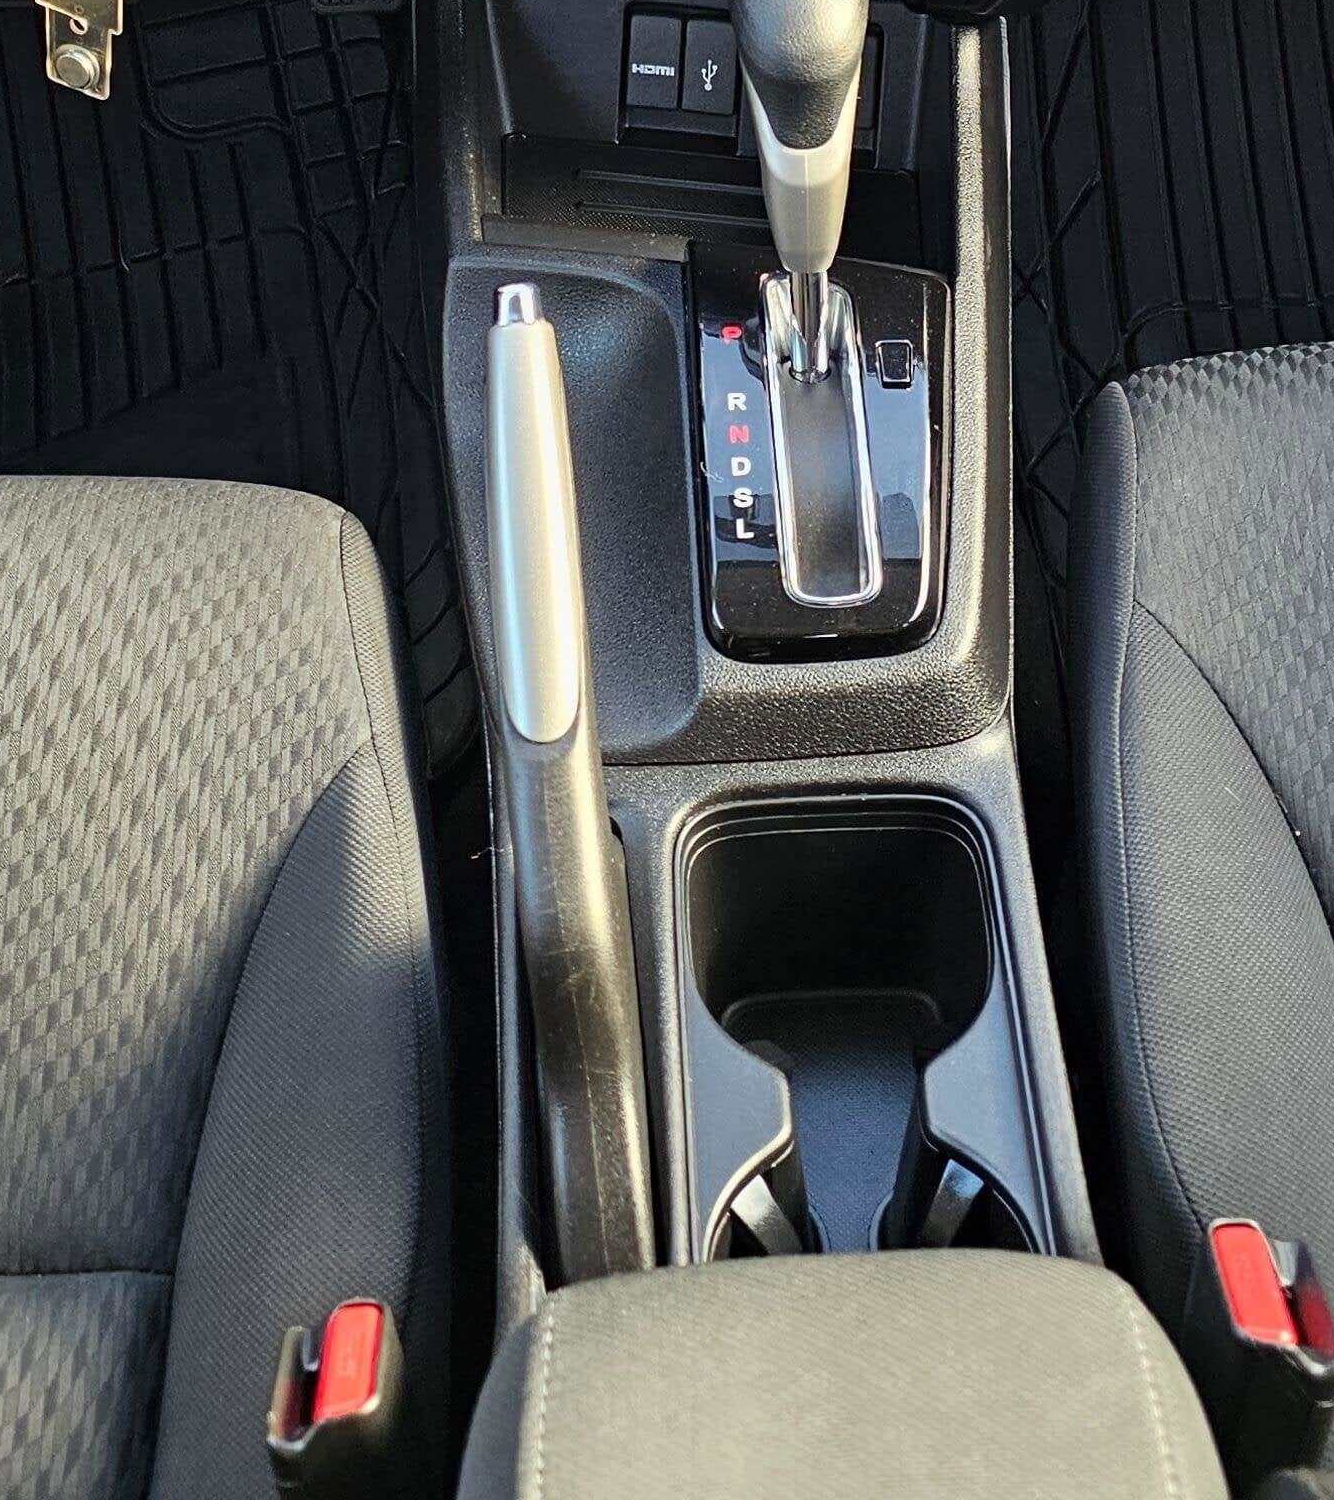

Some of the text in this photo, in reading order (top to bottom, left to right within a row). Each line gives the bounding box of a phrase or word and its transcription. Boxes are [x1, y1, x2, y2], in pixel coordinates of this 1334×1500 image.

[631, 62, 675, 78] HDMI
[722, 325, 744, 345] P
[727, 392, 747, 412] R
[729, 424, 750, 444] N
[731, 456, 752, 477] D
[732, 487, 754, 508] S
[735, 518, 755, 539] L
